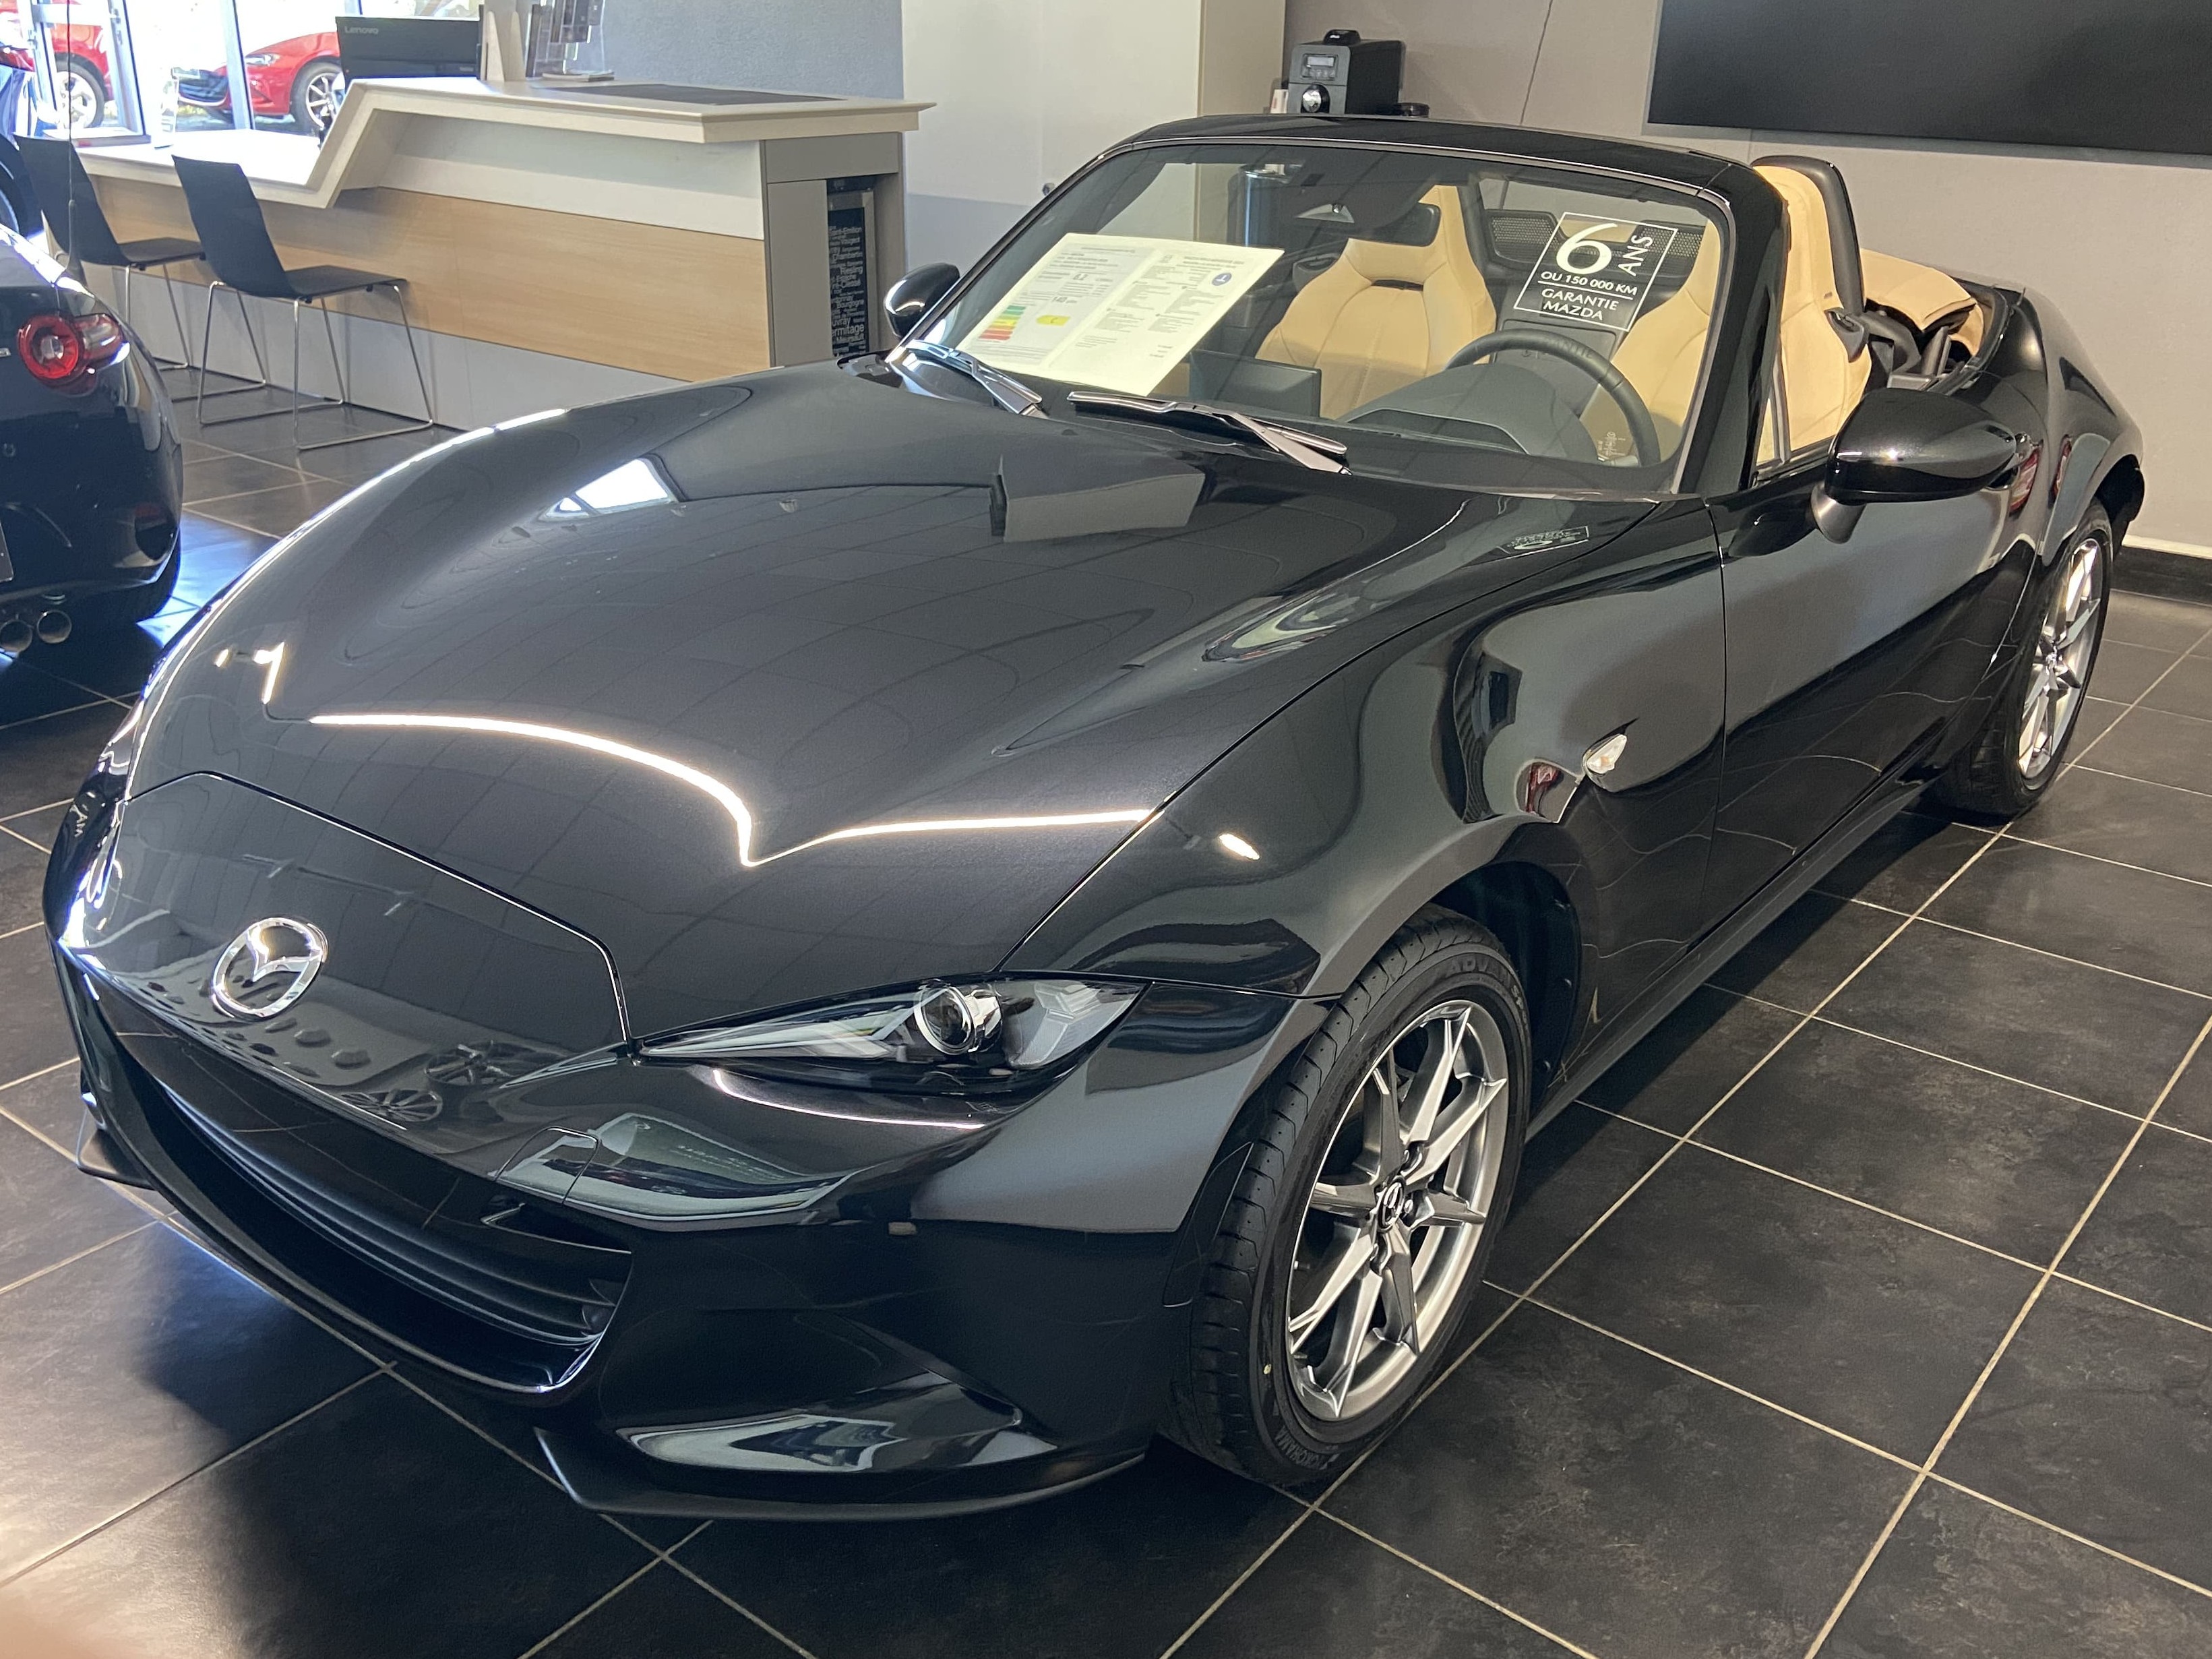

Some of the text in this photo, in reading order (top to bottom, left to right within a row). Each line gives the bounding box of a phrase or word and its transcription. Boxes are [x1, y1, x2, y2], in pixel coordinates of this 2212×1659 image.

[1556, 222, 1618, 275] 6
[1618, 235, 1653, 277] ANS
[1541, 270, 1638, 296] OU 150 000 KM
[1541, 288, 1620, 311] GARANTIE
[1543, 300, 1604, 321] MAZDA
